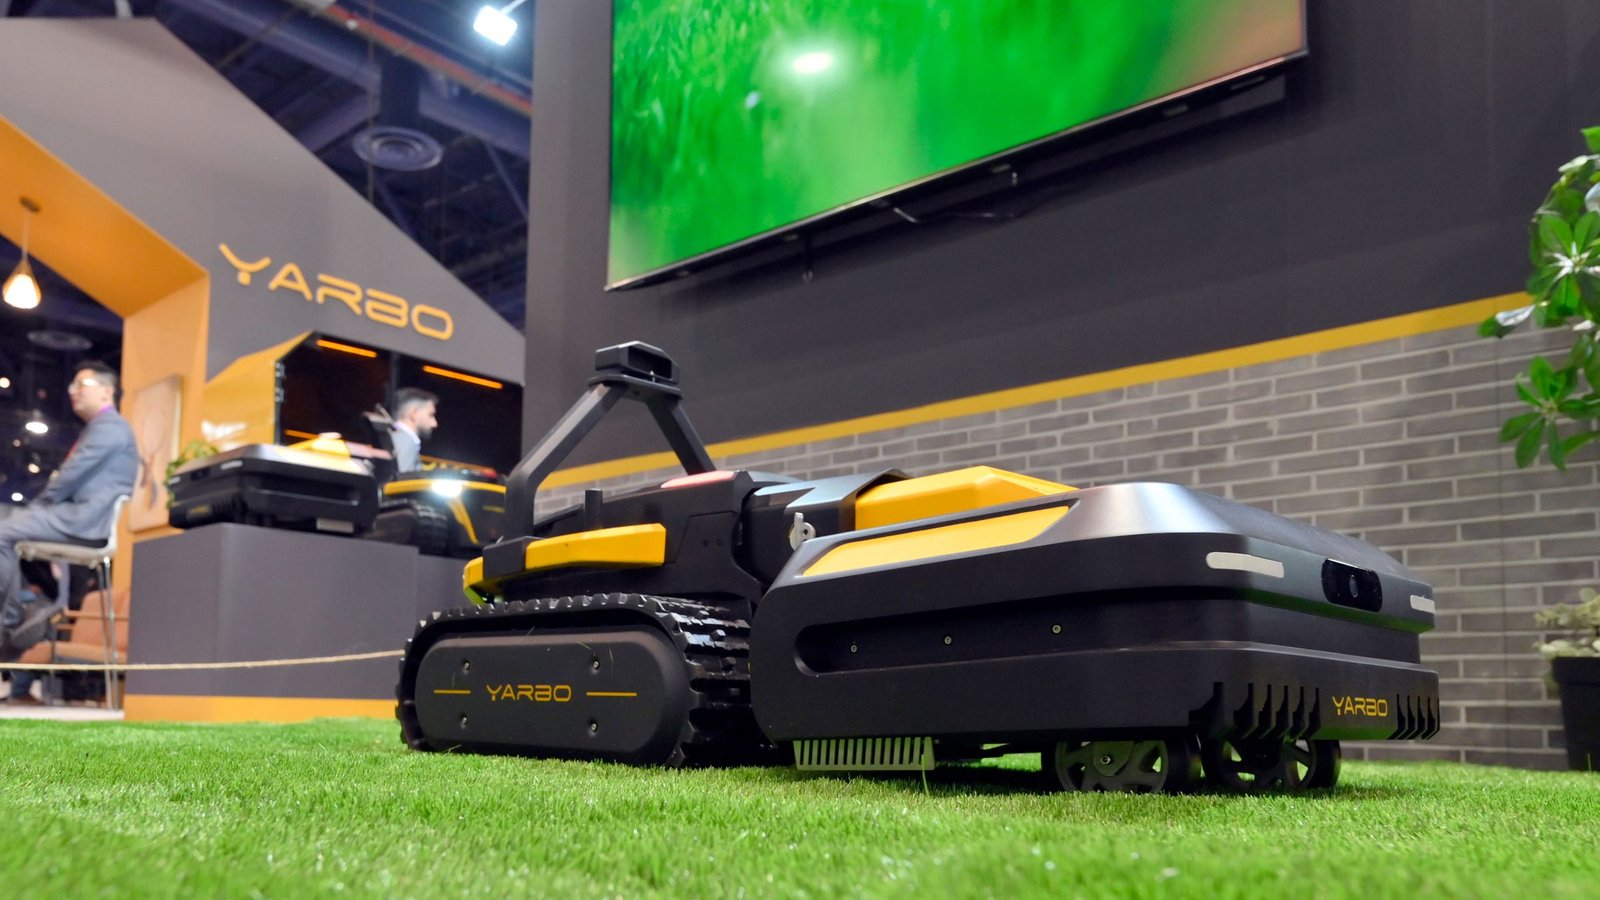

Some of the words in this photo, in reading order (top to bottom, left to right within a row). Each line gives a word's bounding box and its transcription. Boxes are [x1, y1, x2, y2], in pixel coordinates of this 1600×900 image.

[219, 243, 454, 341] YARBO
[486, 684, 572, 702] YARBO
[1332, 696, 1389, 717] YARBO
